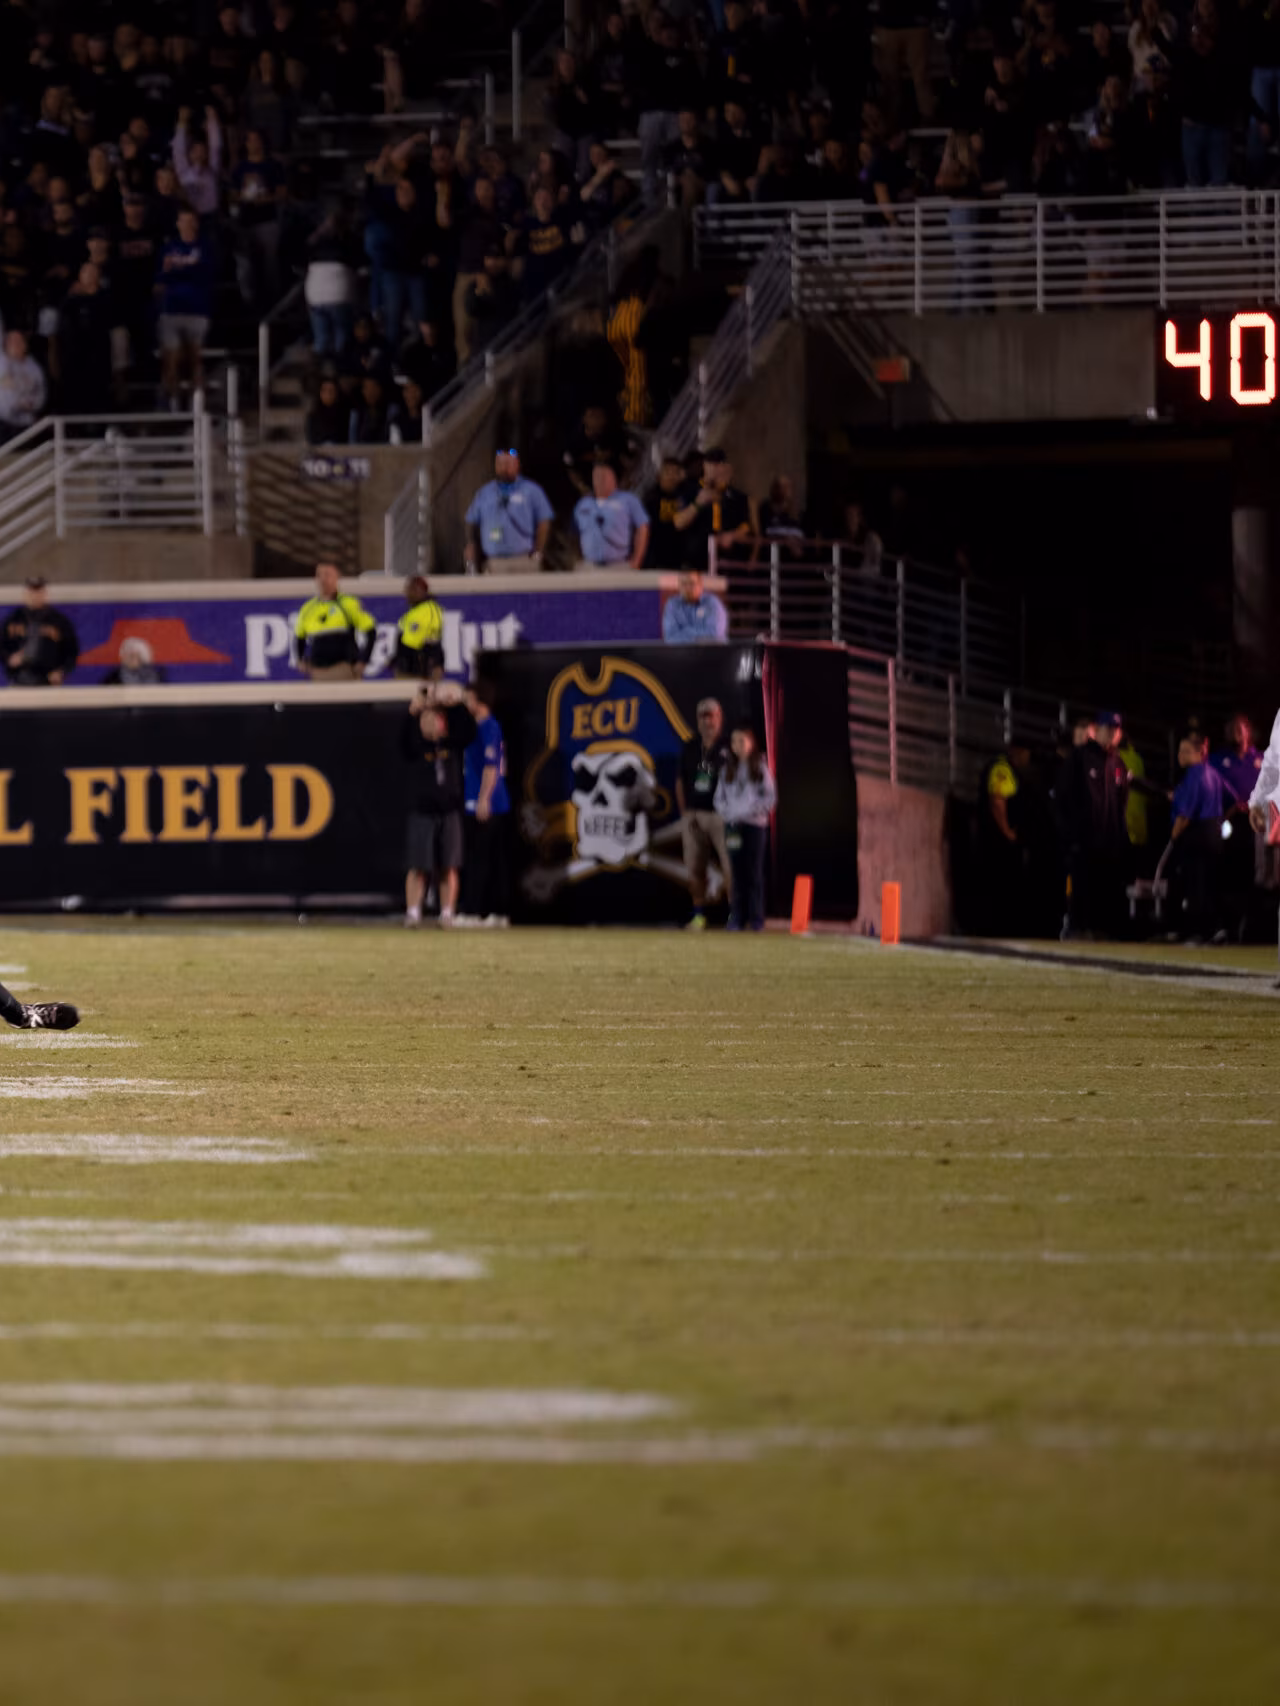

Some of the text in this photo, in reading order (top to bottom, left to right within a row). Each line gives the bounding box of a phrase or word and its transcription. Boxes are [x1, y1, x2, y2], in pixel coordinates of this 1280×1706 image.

[1164, 311, 1275, 405] 40
[571, 697, 639, 740] ECU
[64, 763, 336, 845] FIELD
